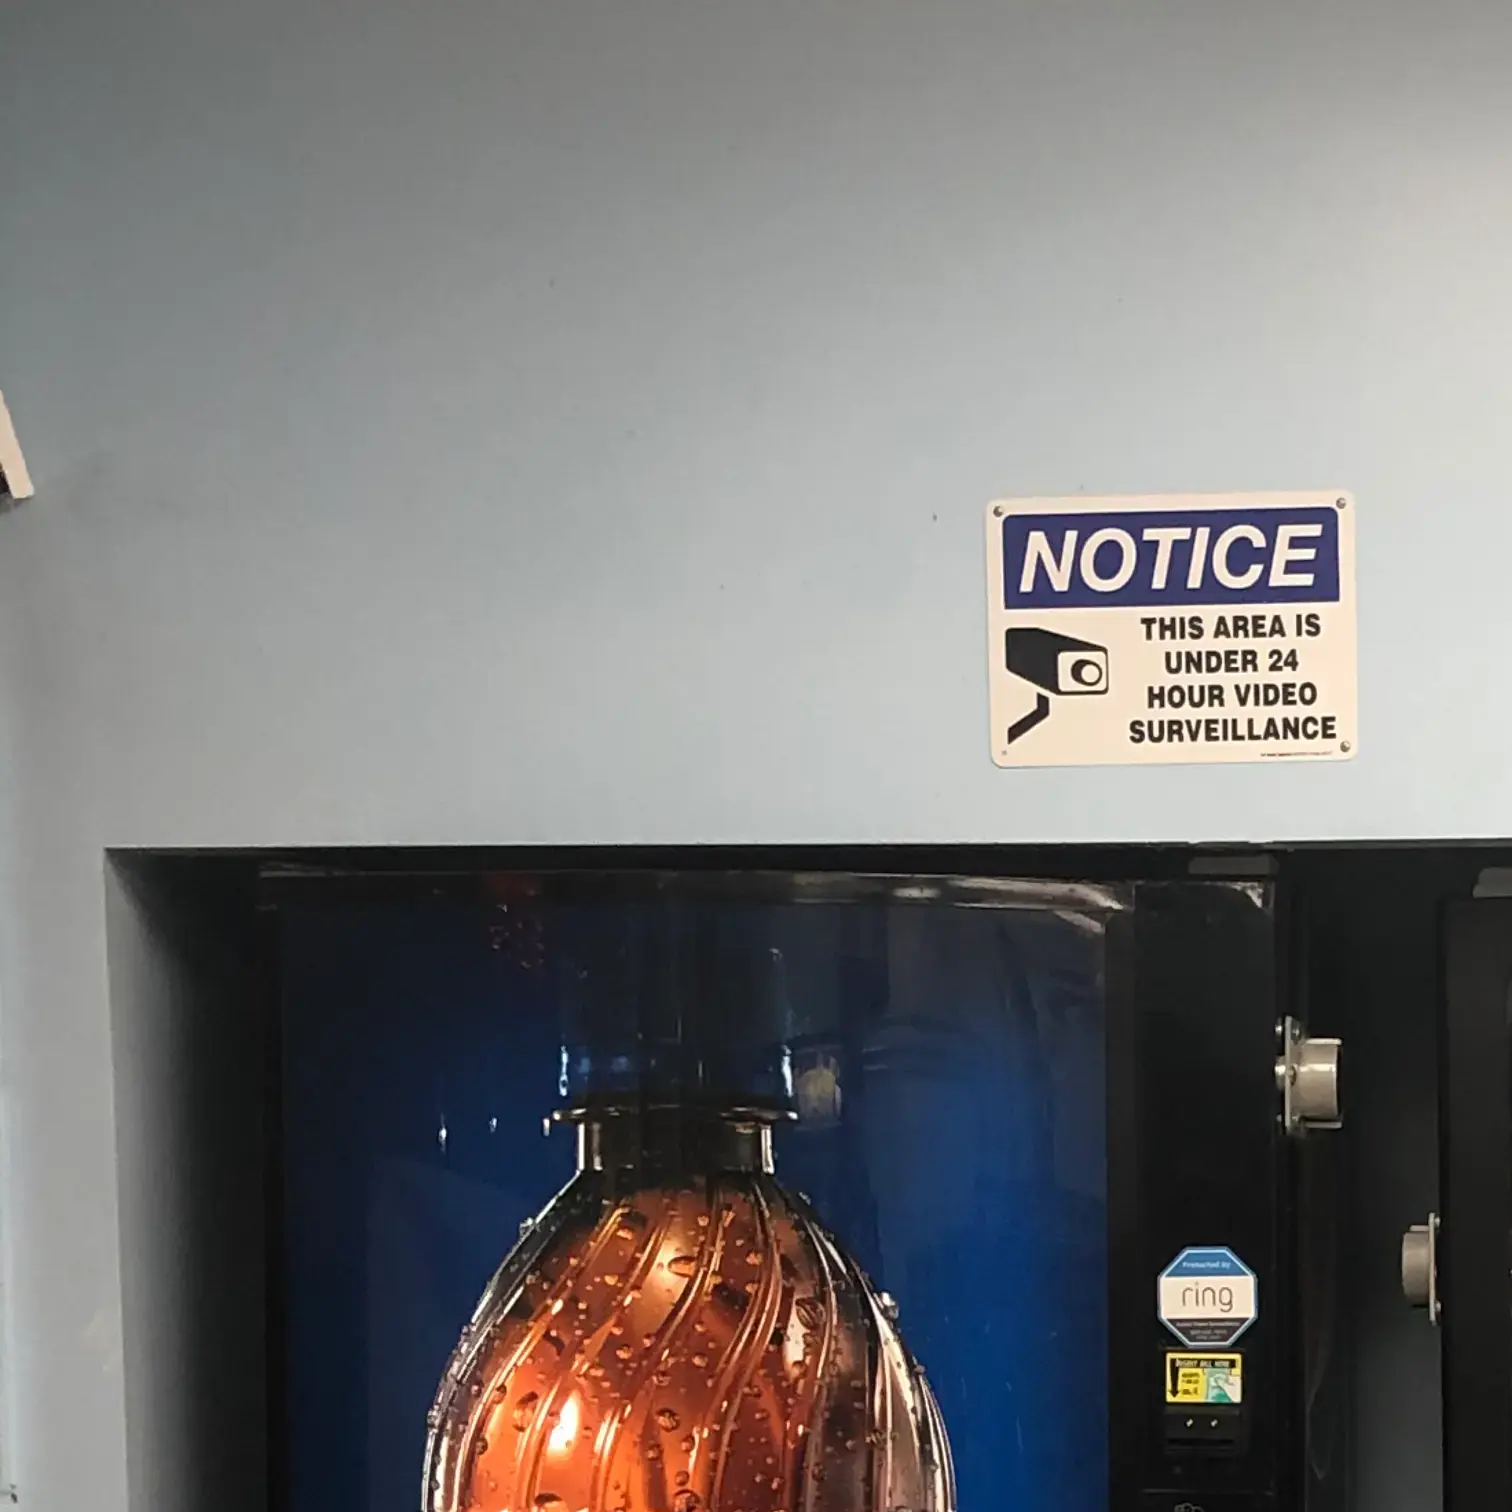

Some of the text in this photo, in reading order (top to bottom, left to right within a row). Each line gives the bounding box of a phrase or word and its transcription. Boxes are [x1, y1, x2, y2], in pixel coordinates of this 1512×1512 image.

[1019, 524, 1323, 593] NOTICE
[1140, 613, 1321, 640] THIS AREA IS
[1165, 649, 1299, 674] UNDER 24
[1147, 682, 1317, 708] HOUR VIDEO
[1129, 716, 1336, 743] SURVEILLANCE
[1182, 1282, 1234, 1313] ring
